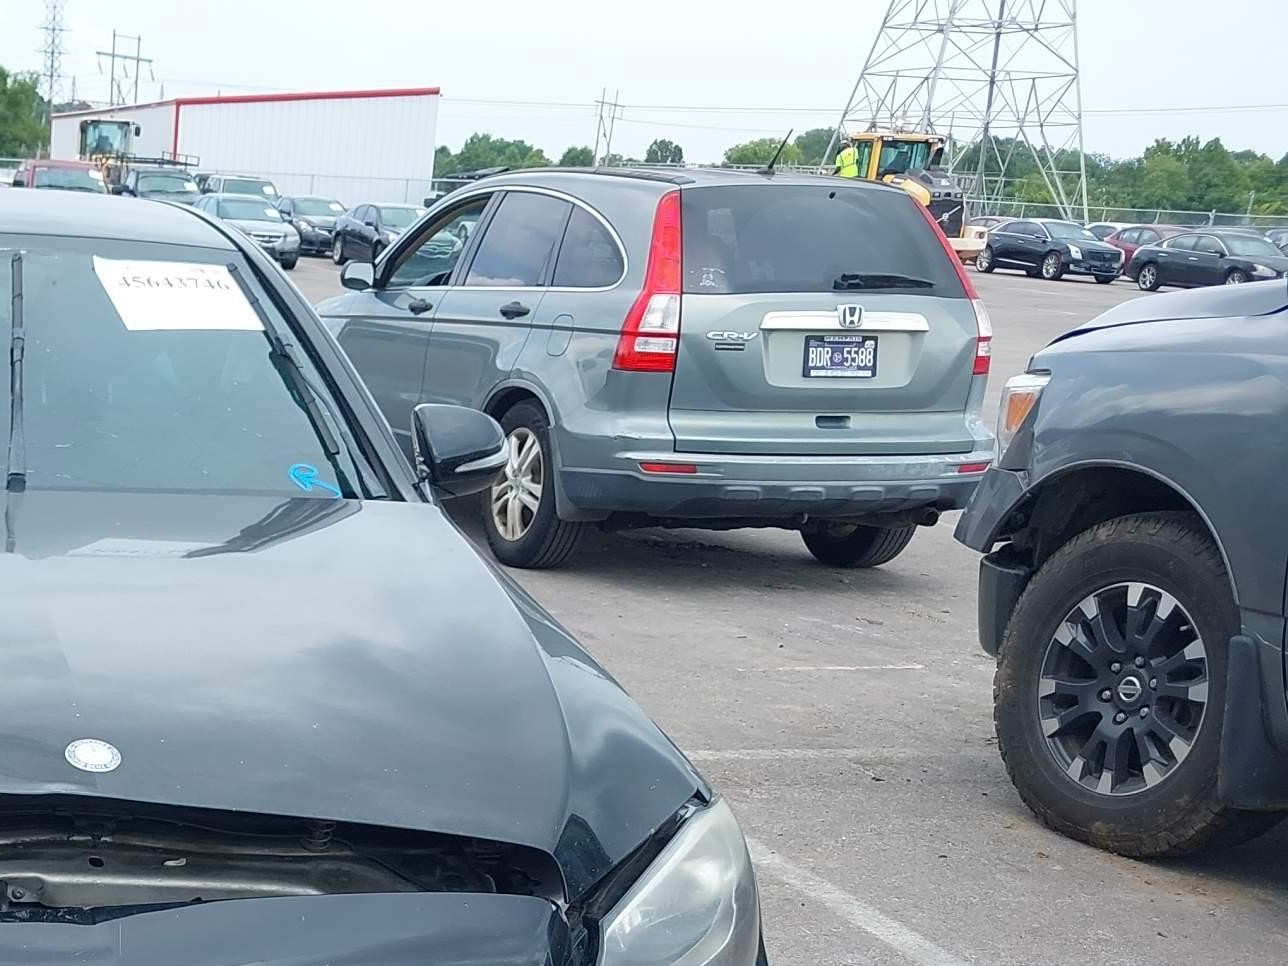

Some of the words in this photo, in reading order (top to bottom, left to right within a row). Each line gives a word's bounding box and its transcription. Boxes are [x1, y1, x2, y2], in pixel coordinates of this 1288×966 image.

[706, 331, 758, 341] CR-V
[808, 347, 831, 367] BDR
[843, 347, 874, 367] 5588
